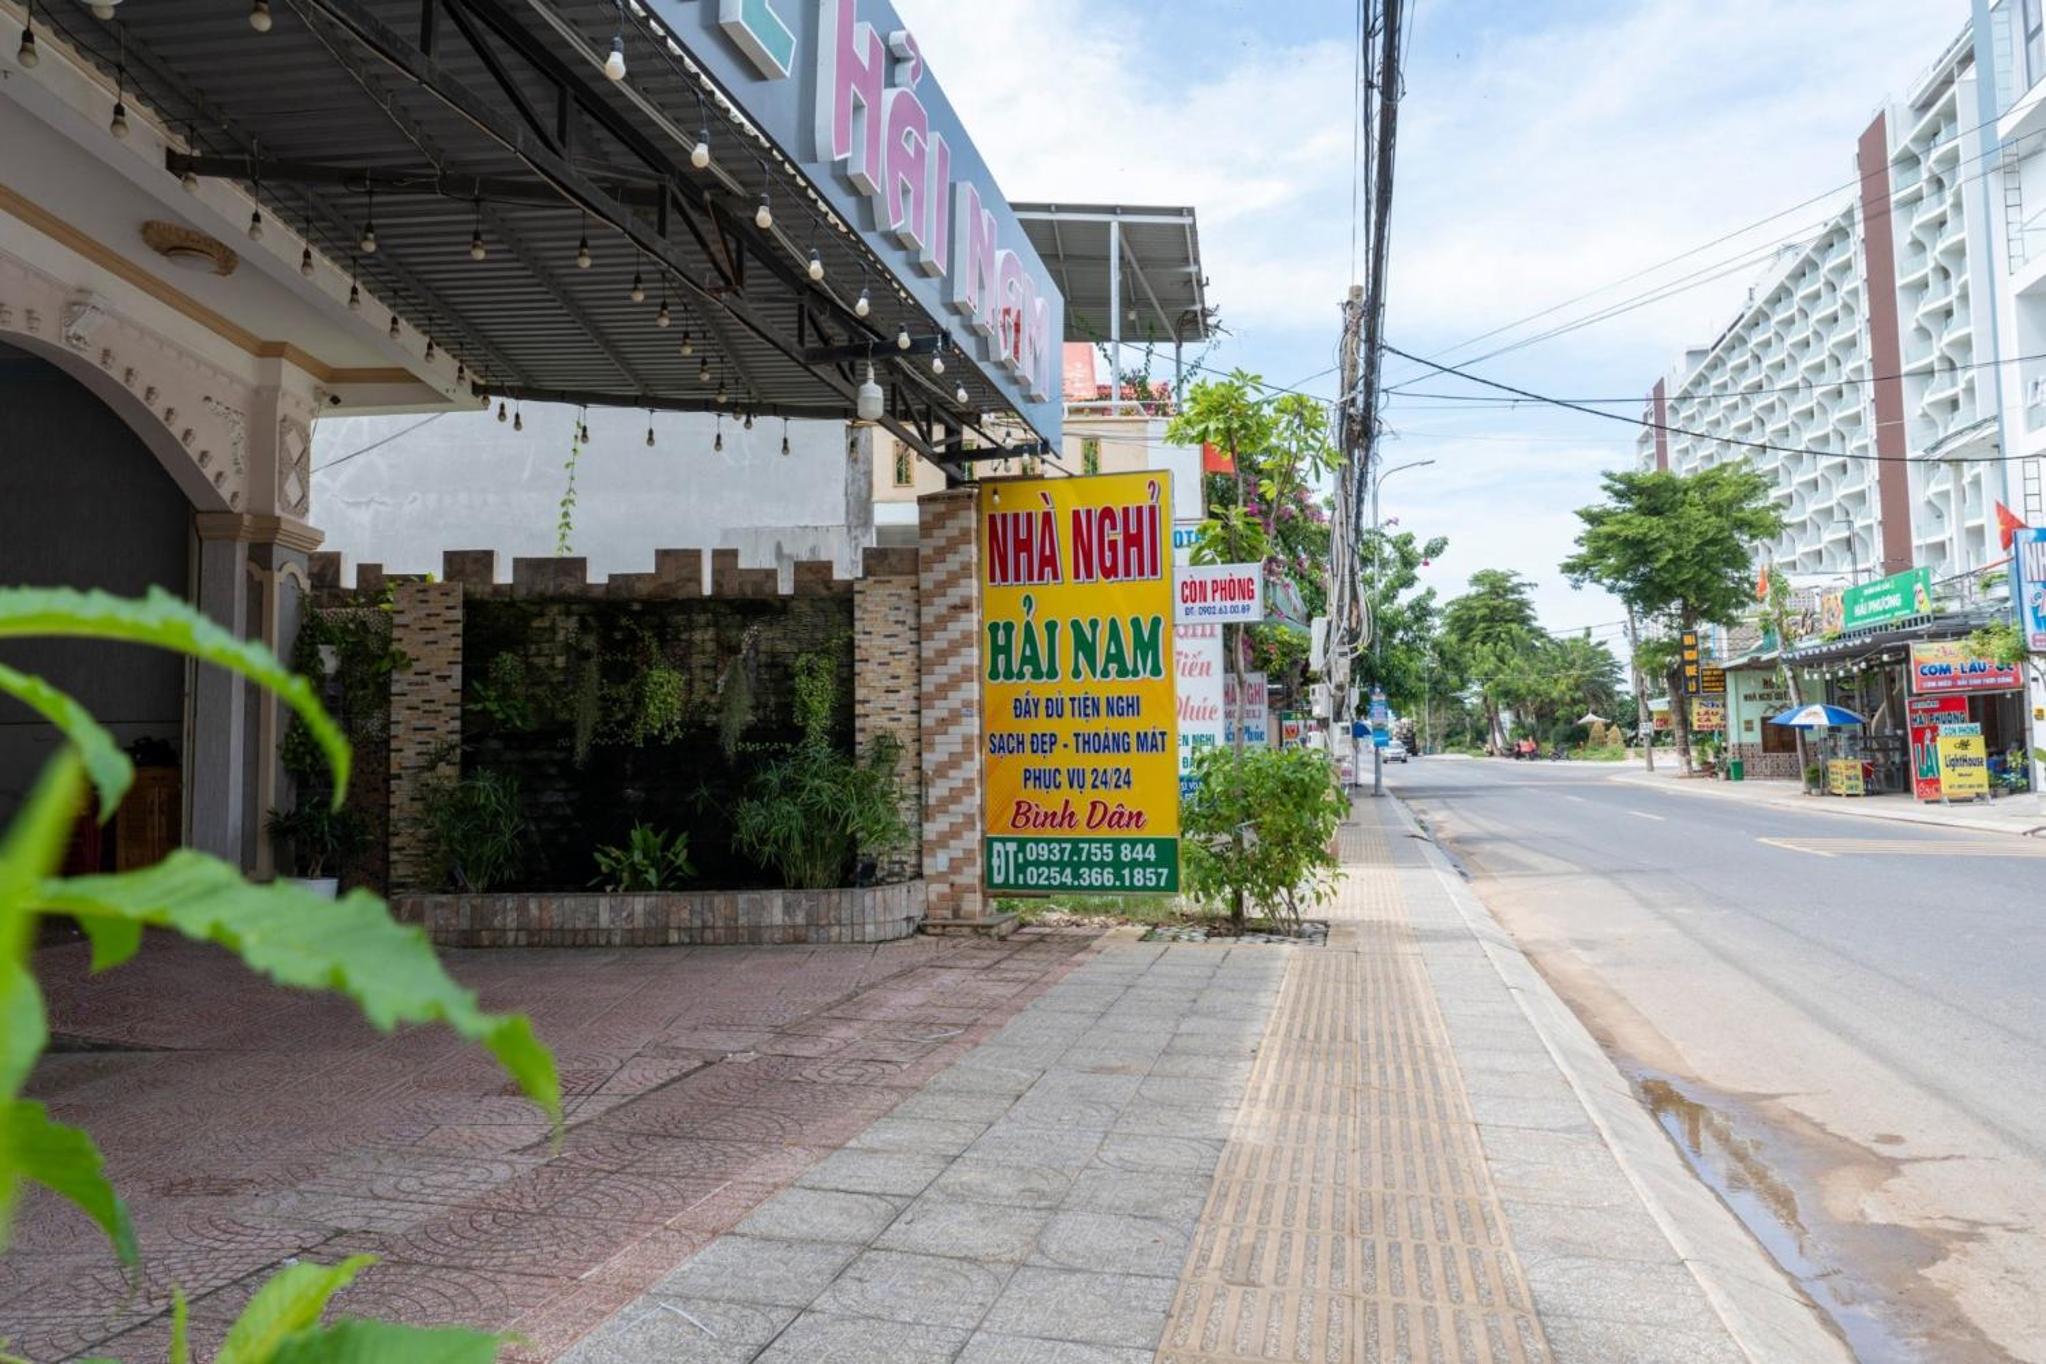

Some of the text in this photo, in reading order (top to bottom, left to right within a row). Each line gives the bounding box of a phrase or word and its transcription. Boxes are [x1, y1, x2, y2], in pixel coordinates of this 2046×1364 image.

[817, 0, 1050, 402] HẢI NAM
[987, 480, 1161, 585] NHÀ NGHỈ
[1181, 572, 1255, 604] CÒN PHÒNG
[987, 594, 1163, 682] HẢI NAM
[1069, 691, 1100, 723] TIỆN
[1106, 695, 1140, 717] NGHI
[989, 733, 1025, 759] SẠCH
[1030, 732, 1058, 759] ĐẸP
[1073, 726, 1131, 754] THOÁNG
[1136, 725, 1168, 753] MÁT
[1023, 767, 1132, 795] PHỤC VỤ 24/24
[1010, 798, 1146, 830] Bình Dân
[1120, 842, 1156, 862] 844
[1026, 867, 1169, 887] 0254.366.1857
